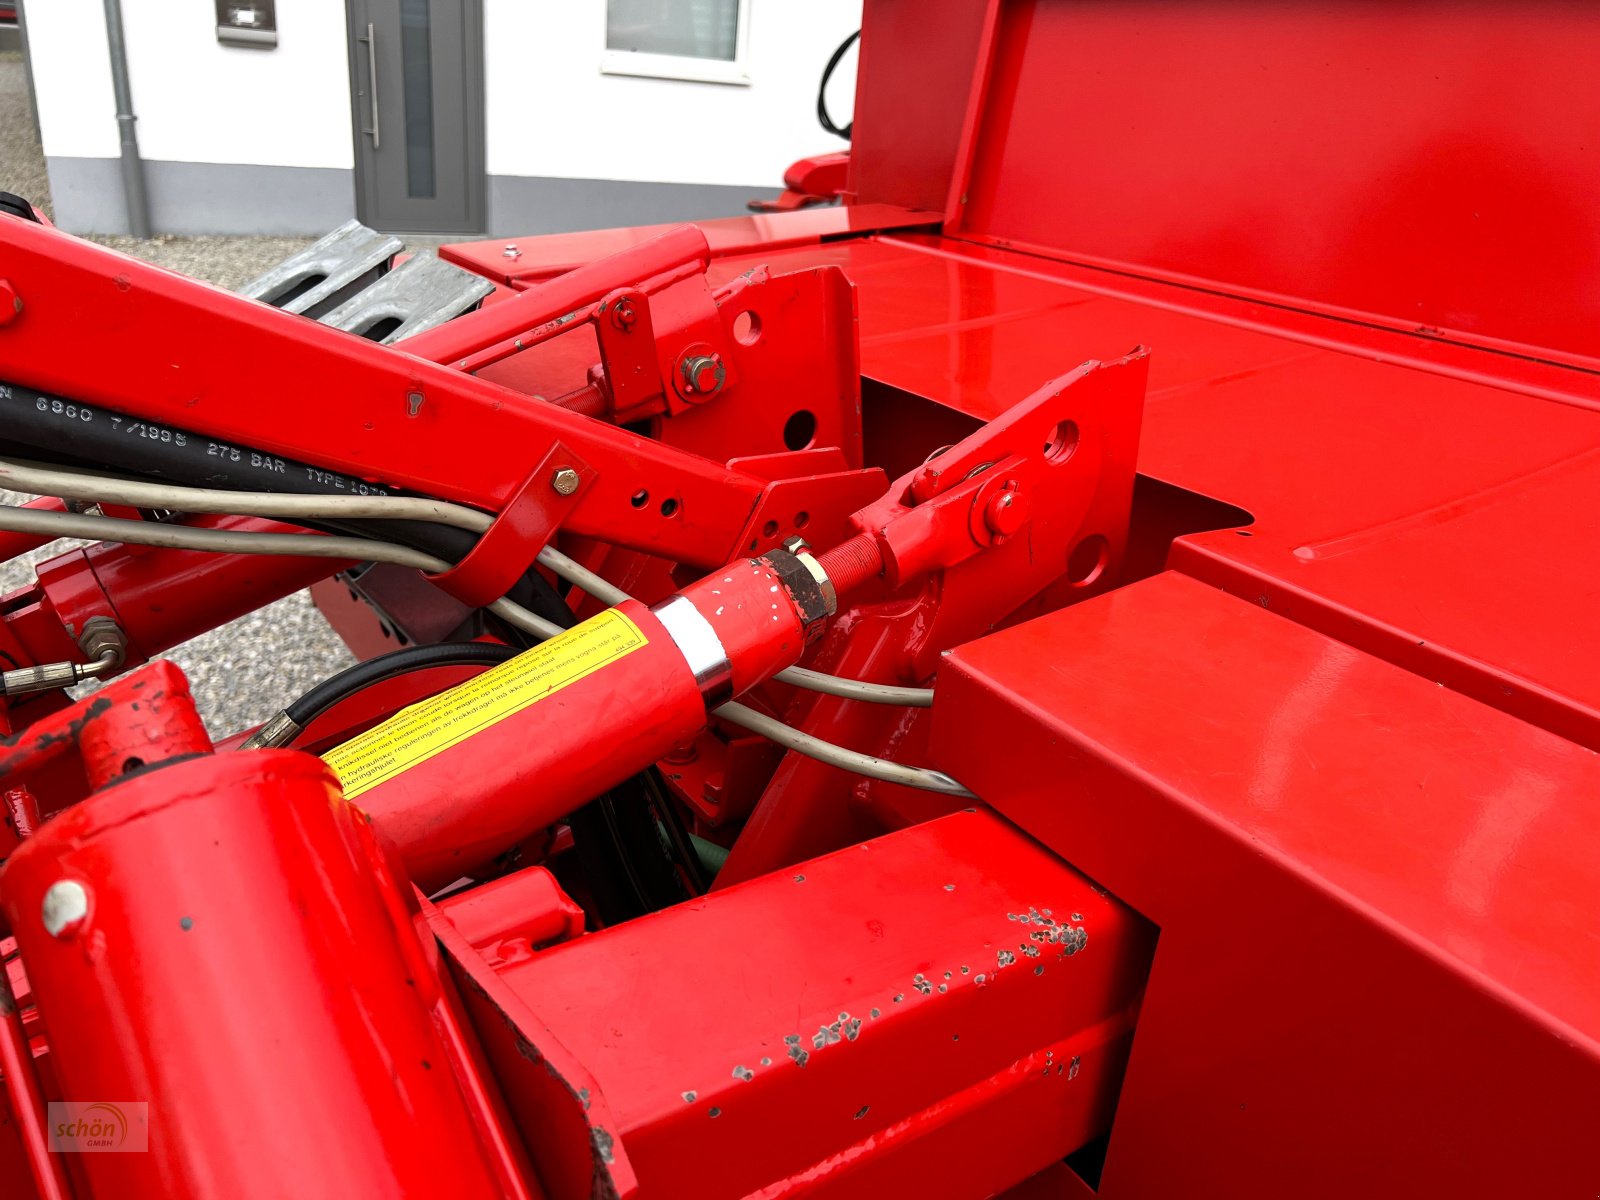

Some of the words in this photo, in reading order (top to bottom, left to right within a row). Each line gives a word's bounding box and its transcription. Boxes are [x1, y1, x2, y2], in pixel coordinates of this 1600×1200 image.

[36, 397, 93, 421] 6960
[206, 442, 241, 461] 275
[251, 453, 286, 473] BAR
[306, 467, 345, 489] TYPE
